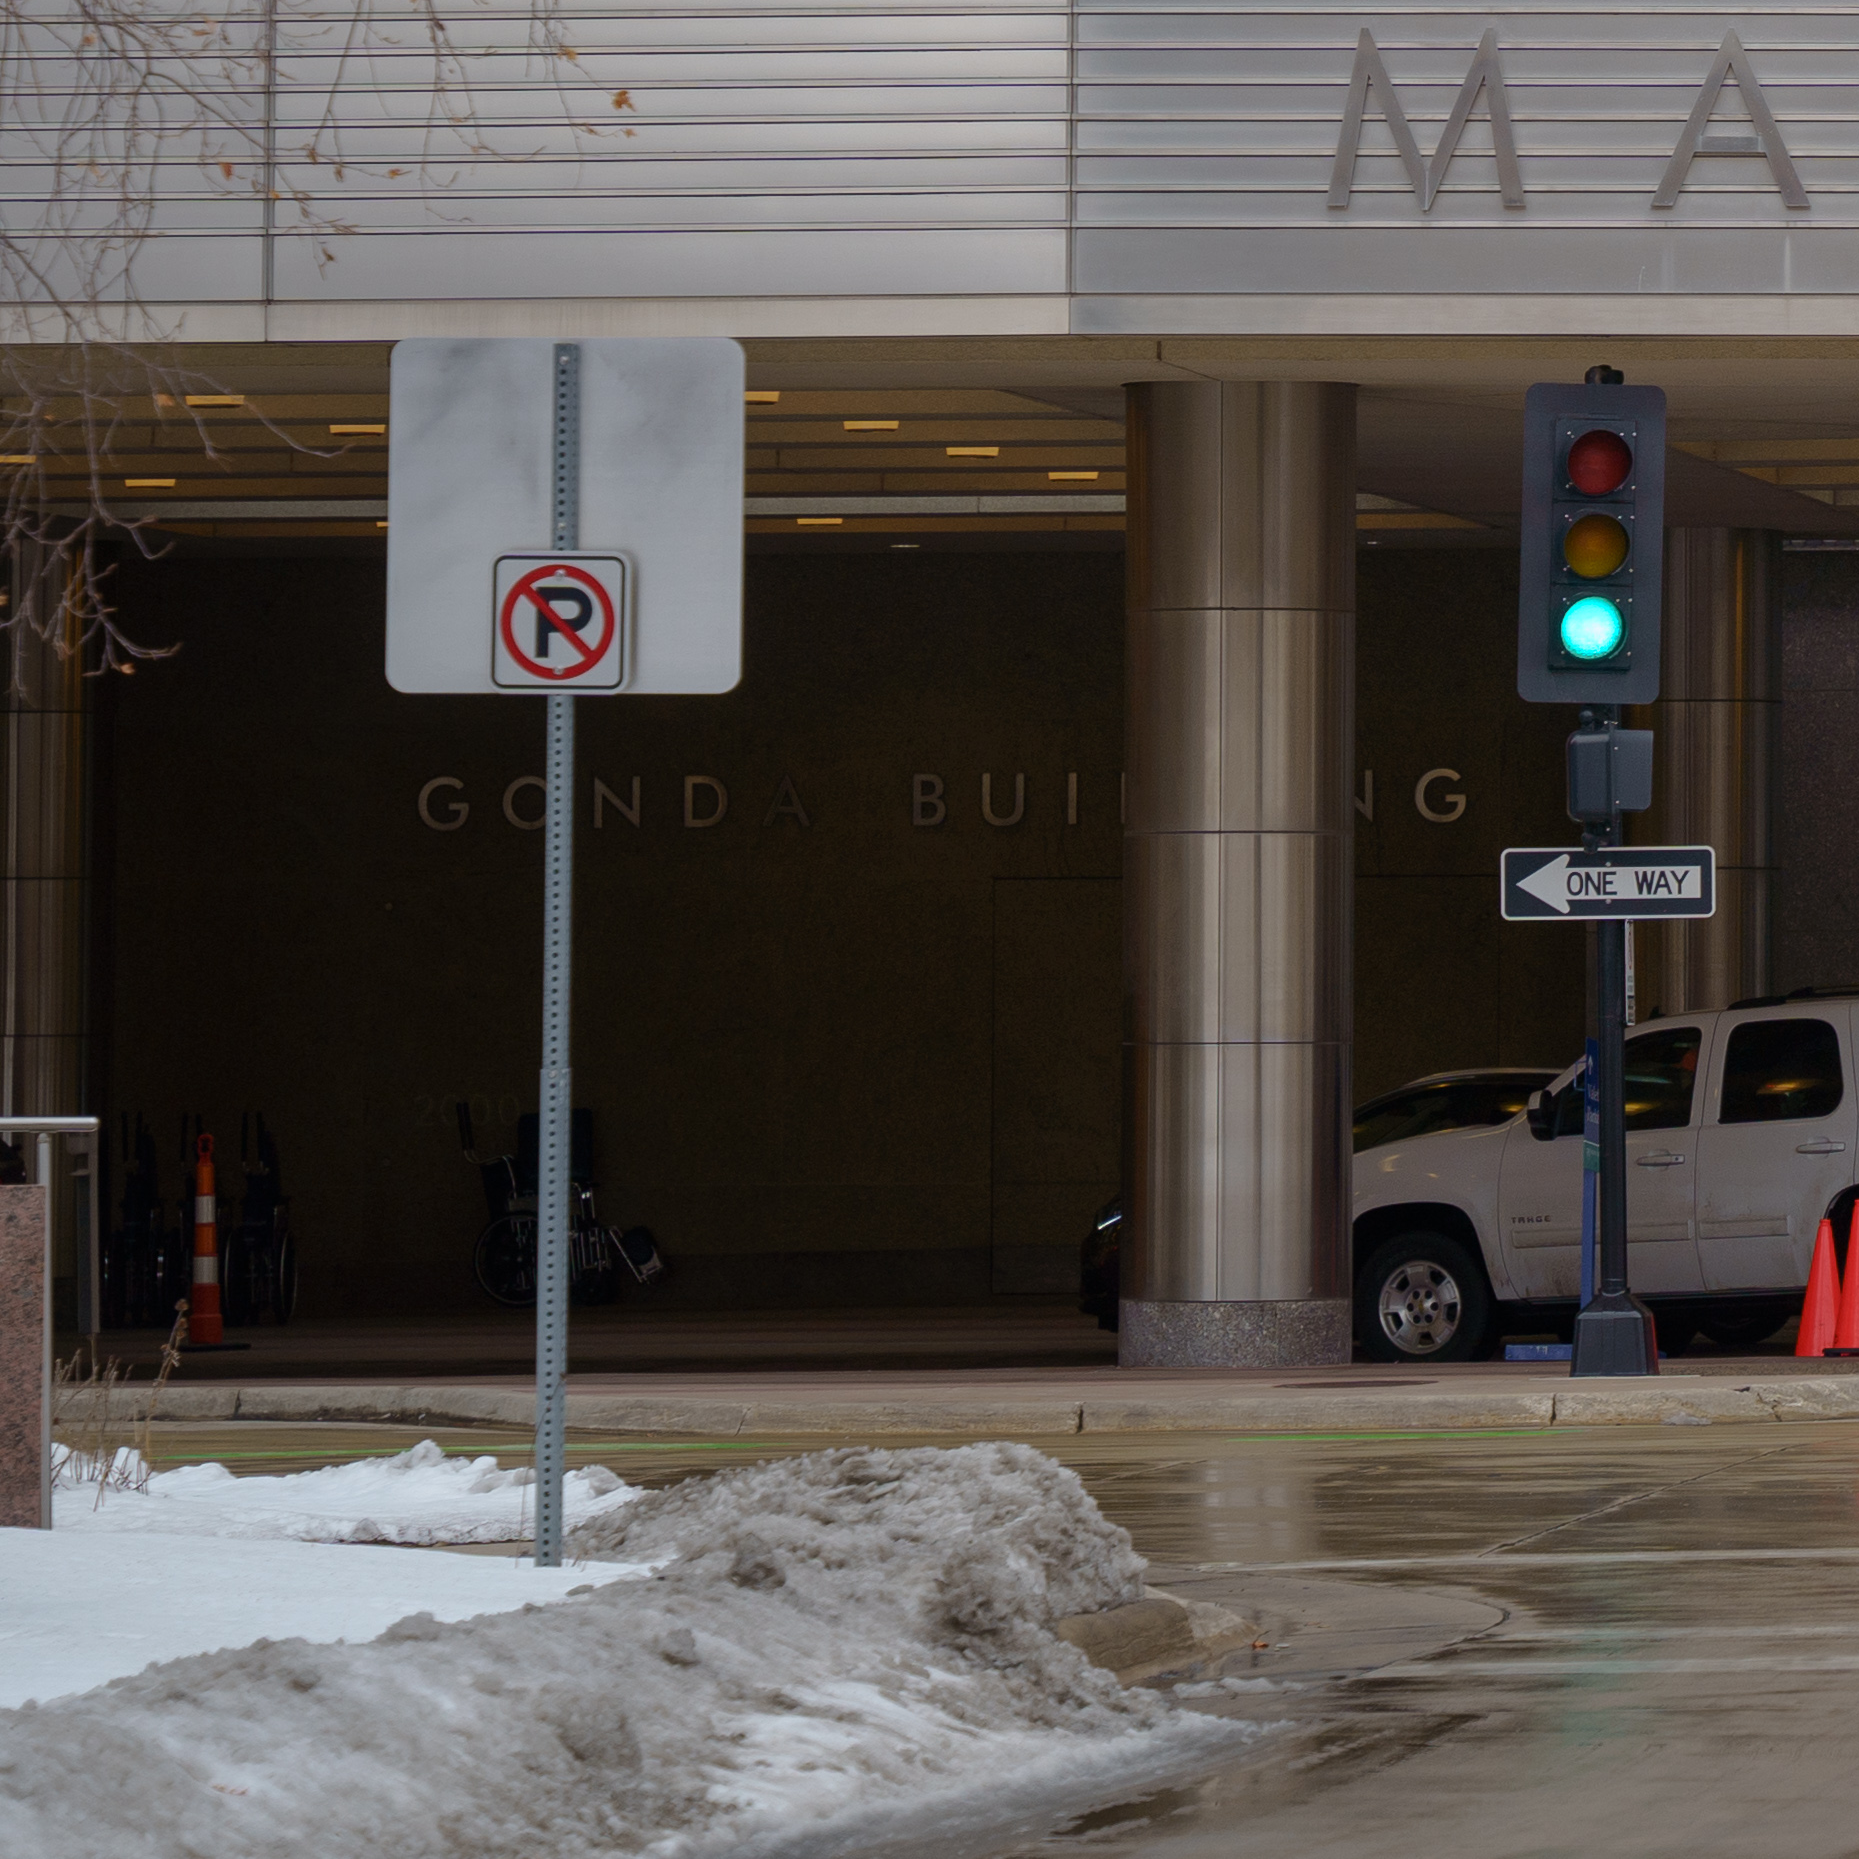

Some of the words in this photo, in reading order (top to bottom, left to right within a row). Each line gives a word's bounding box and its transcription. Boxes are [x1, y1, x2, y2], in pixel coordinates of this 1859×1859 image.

[417, 774, 812, 832] GONDA
[1566, 871, 1618, 897] ONE
[1634, 870, 1690, 896] WAY
[1511, 1214, 1552, 1224] TAHOE
